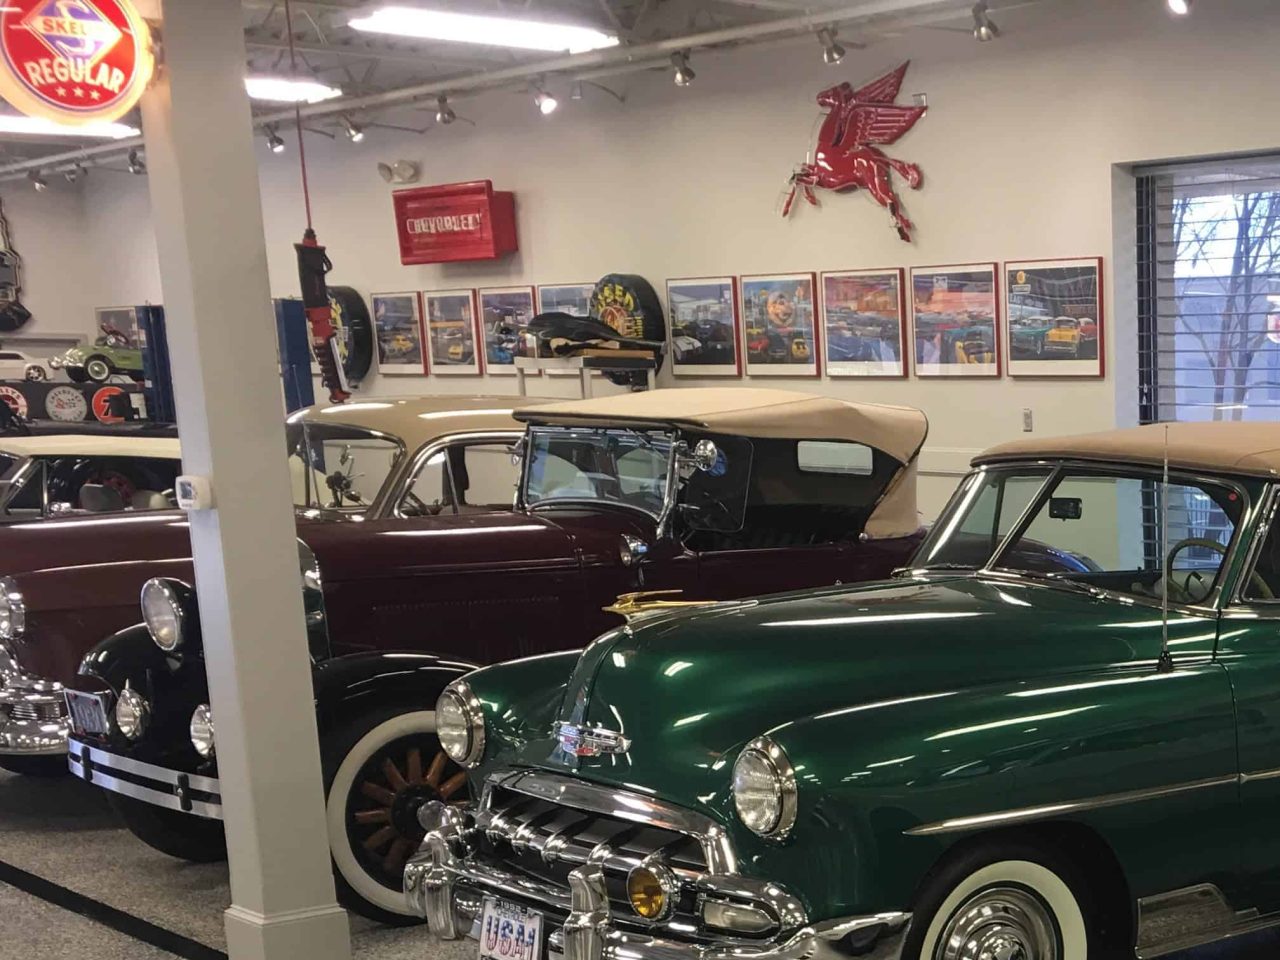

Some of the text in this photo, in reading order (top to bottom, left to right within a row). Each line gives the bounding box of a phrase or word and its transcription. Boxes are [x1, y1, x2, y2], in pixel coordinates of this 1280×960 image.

[42, 18, 92, 37] SKEL
[24, 57, 125, 94] REGULAR
[406, 213, 482, 234] CHEVROLET
